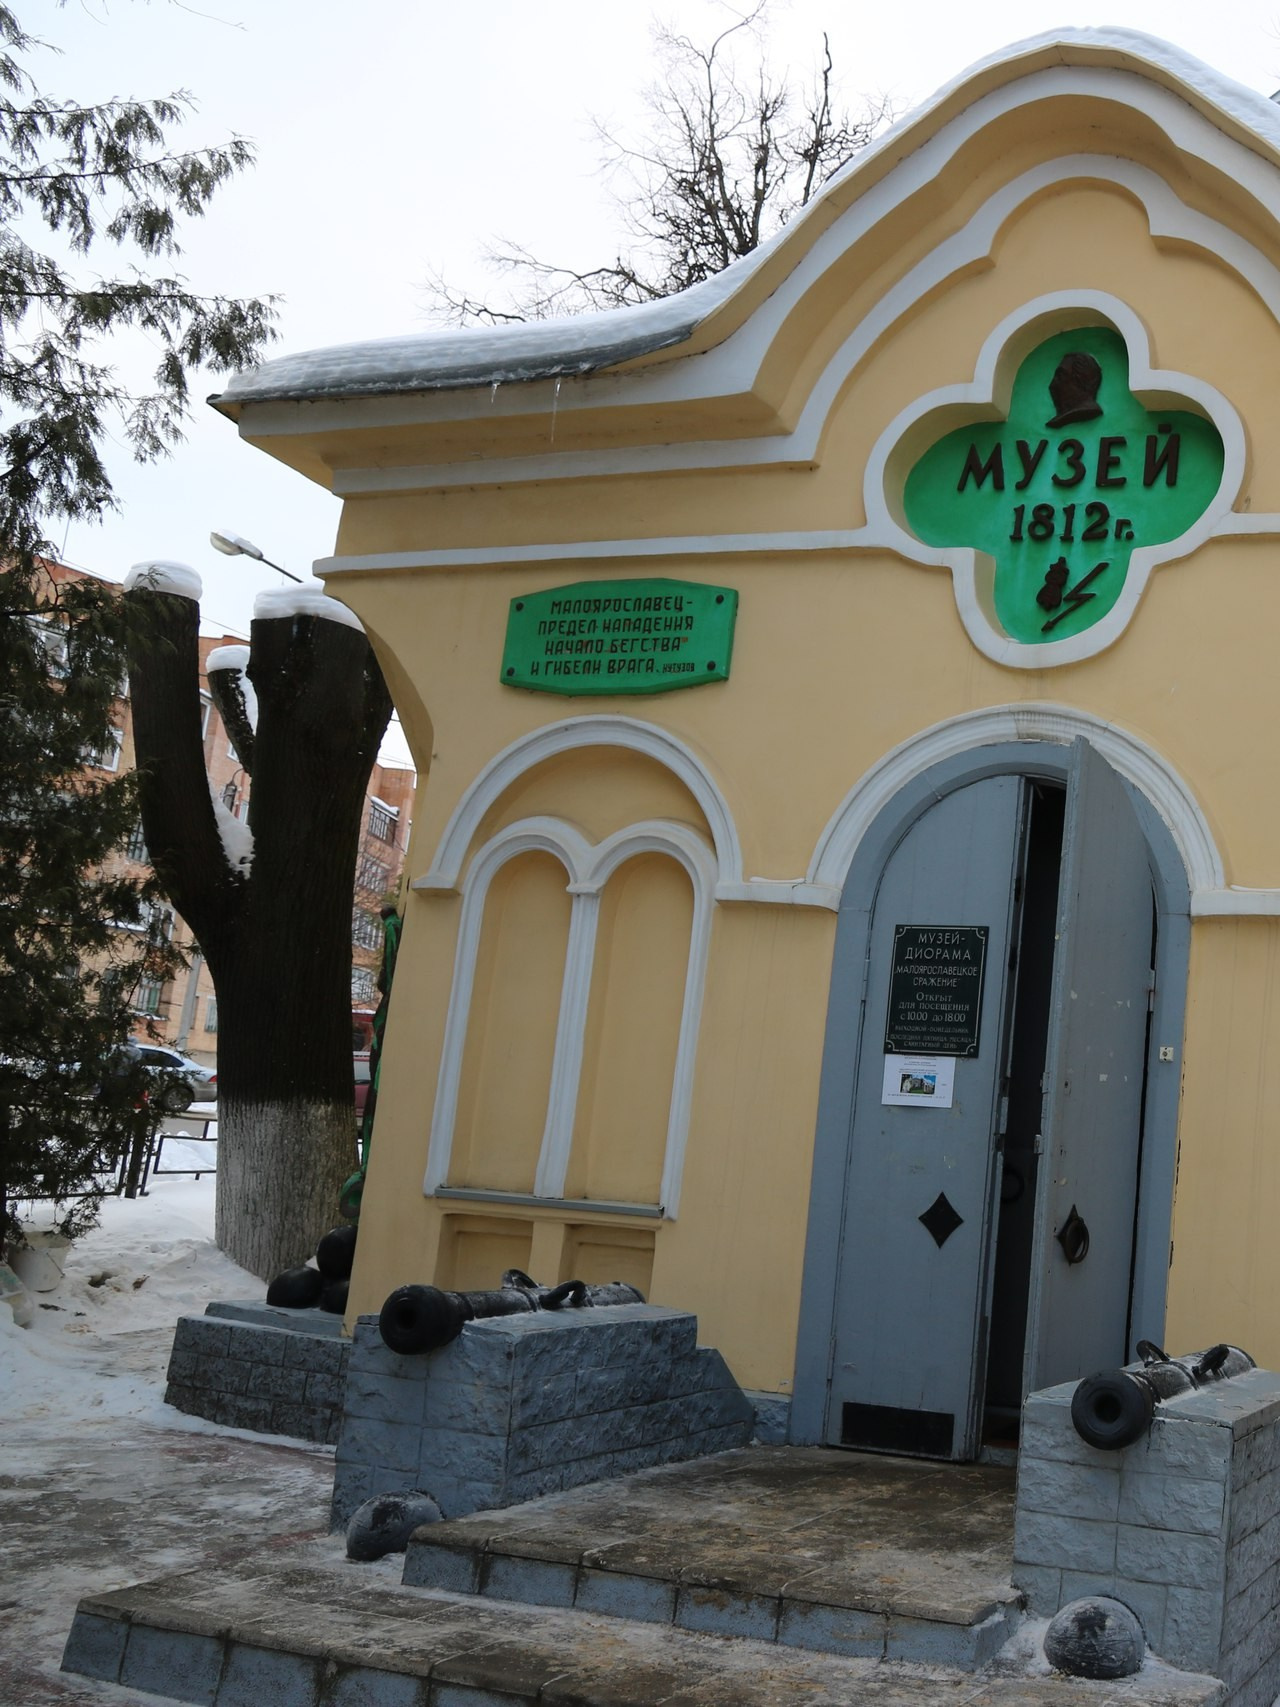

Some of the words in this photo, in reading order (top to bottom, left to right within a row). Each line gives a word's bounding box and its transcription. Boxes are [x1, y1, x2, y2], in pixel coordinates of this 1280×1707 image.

[956, 422, 1181, 493] МУЗЕЙ
[537, 618, 597, 636] ПРЕДЕЛ
[602, 615, 694, 634] НАПАДЕНИЯ
[544, 638, 605, 656] НАЧАЛО
[609, 636, 681, 654] БЕГСТВА
[530, 660, 540, 676] И
[544, 659, 601, 676] ГИБЕЛИ
[662, 662, 695, 674] КУТУЗОВ
[918, 931, 966, 945] МУЗЕЙ-
[904, 947, 971, 961] ДИОРАМА
